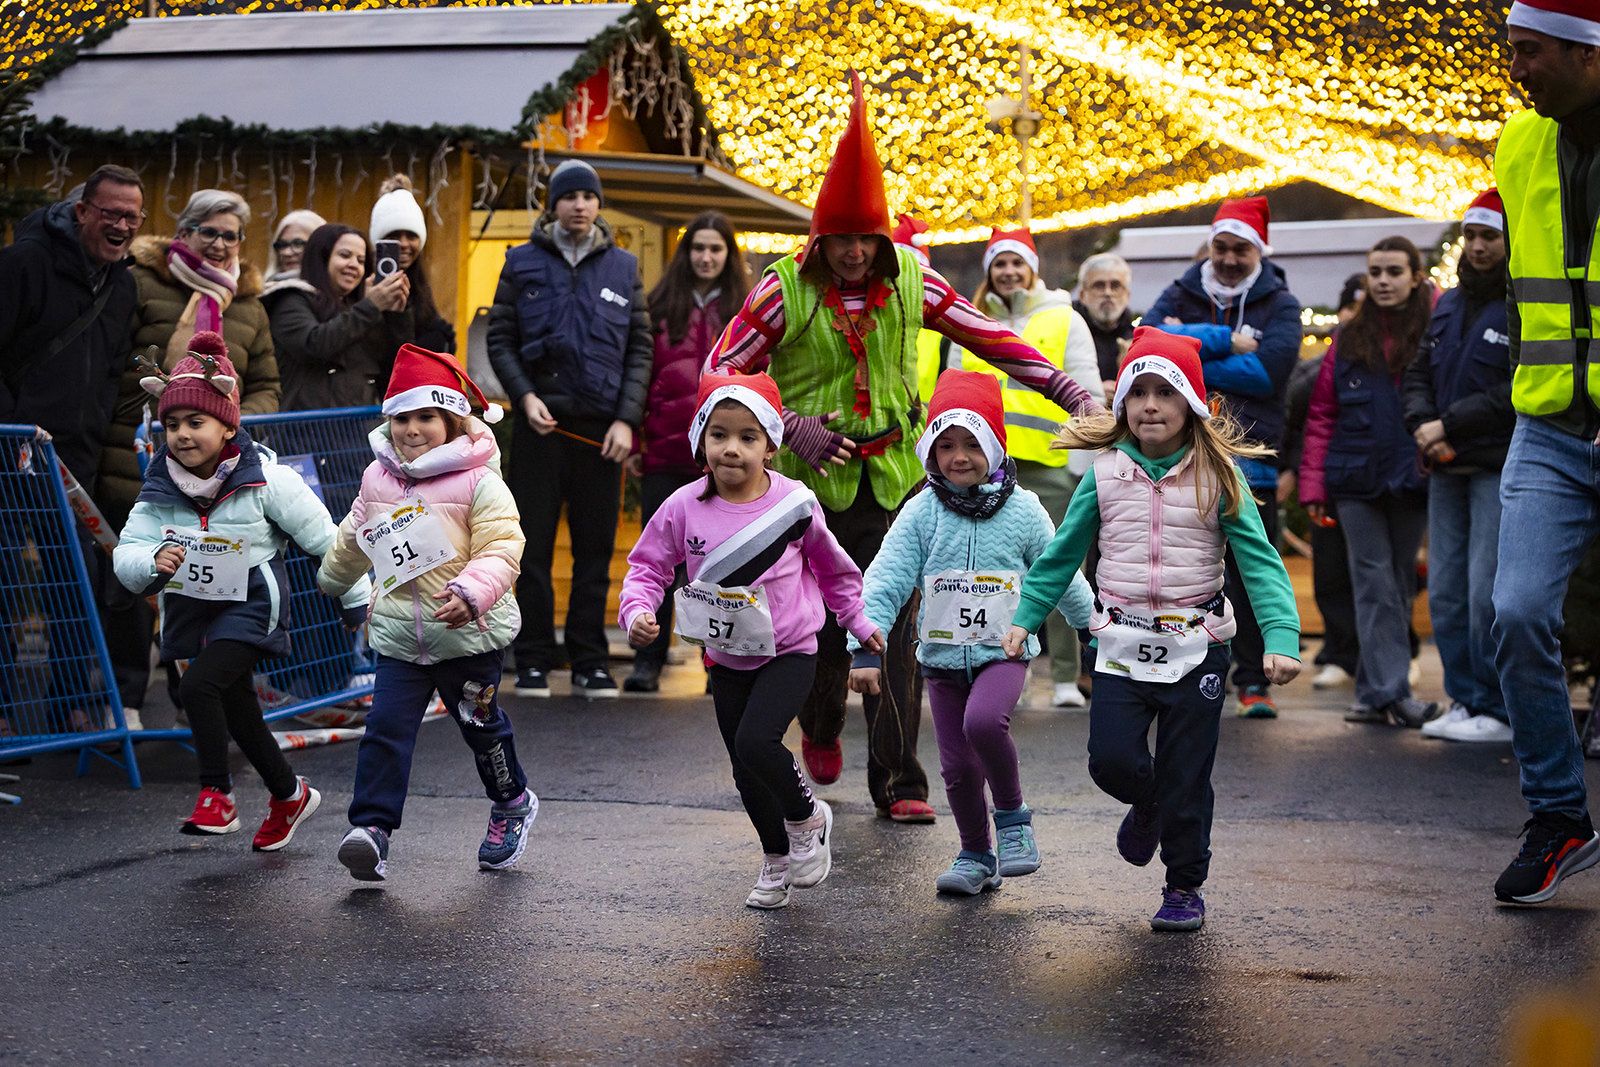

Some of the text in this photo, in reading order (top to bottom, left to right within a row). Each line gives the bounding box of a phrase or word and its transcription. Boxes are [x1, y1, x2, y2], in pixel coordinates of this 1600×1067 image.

[390, 540, 419, 567] 51
[188, 563, 214, 584] 55
[708, 617, 735, 640] 57
[959, 607, 988, 629] 54
[1137, 643, 1169, 665] 52
